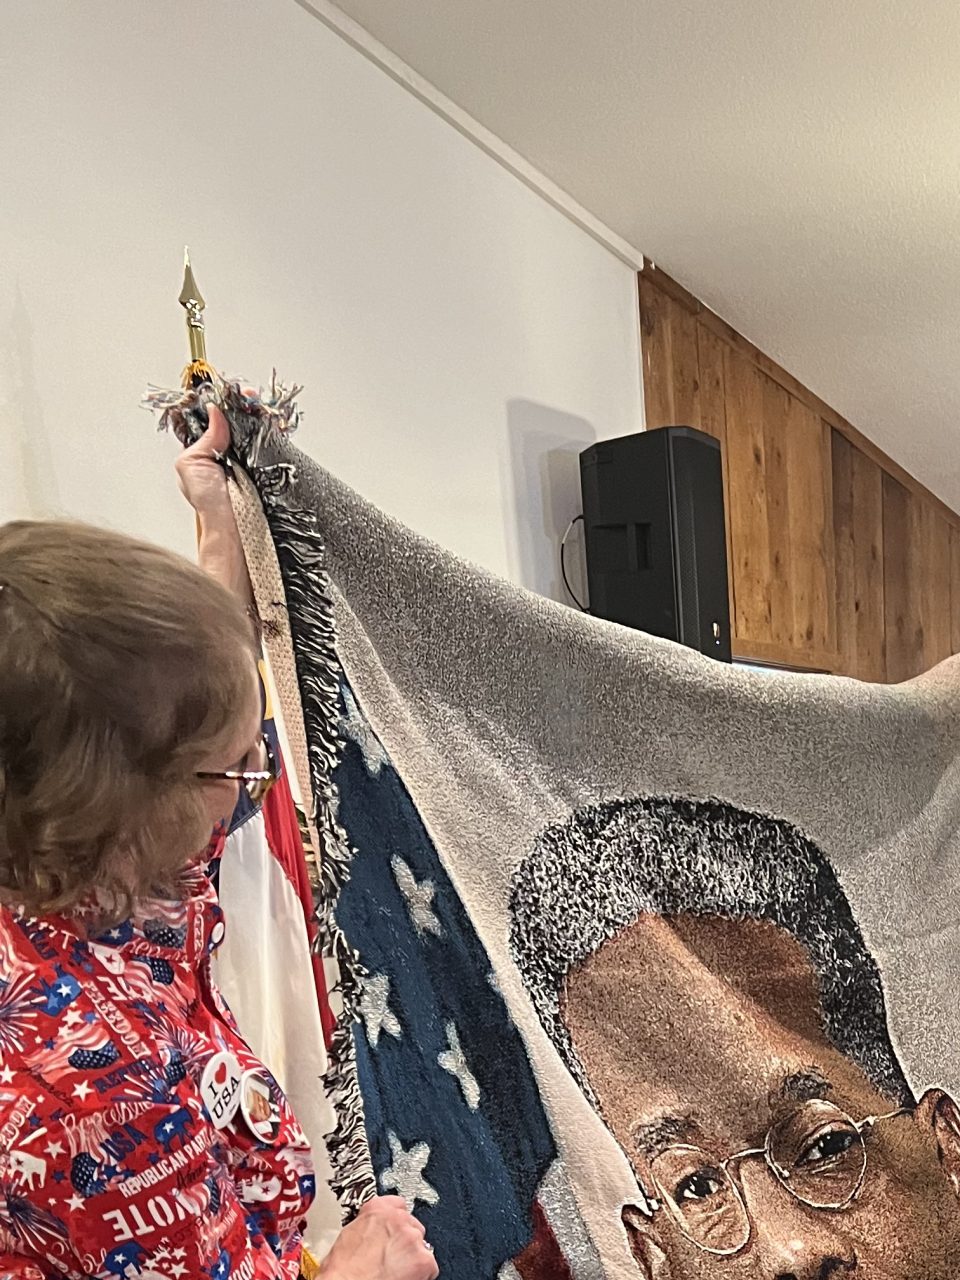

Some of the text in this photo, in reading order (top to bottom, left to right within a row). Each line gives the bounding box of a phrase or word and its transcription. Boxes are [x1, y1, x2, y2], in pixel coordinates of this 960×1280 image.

[208, 1081, 219, 1099] I
[212, 1076, 241, 1120] USA
[118, 1150, 189, 1198] REPUBLICAN
